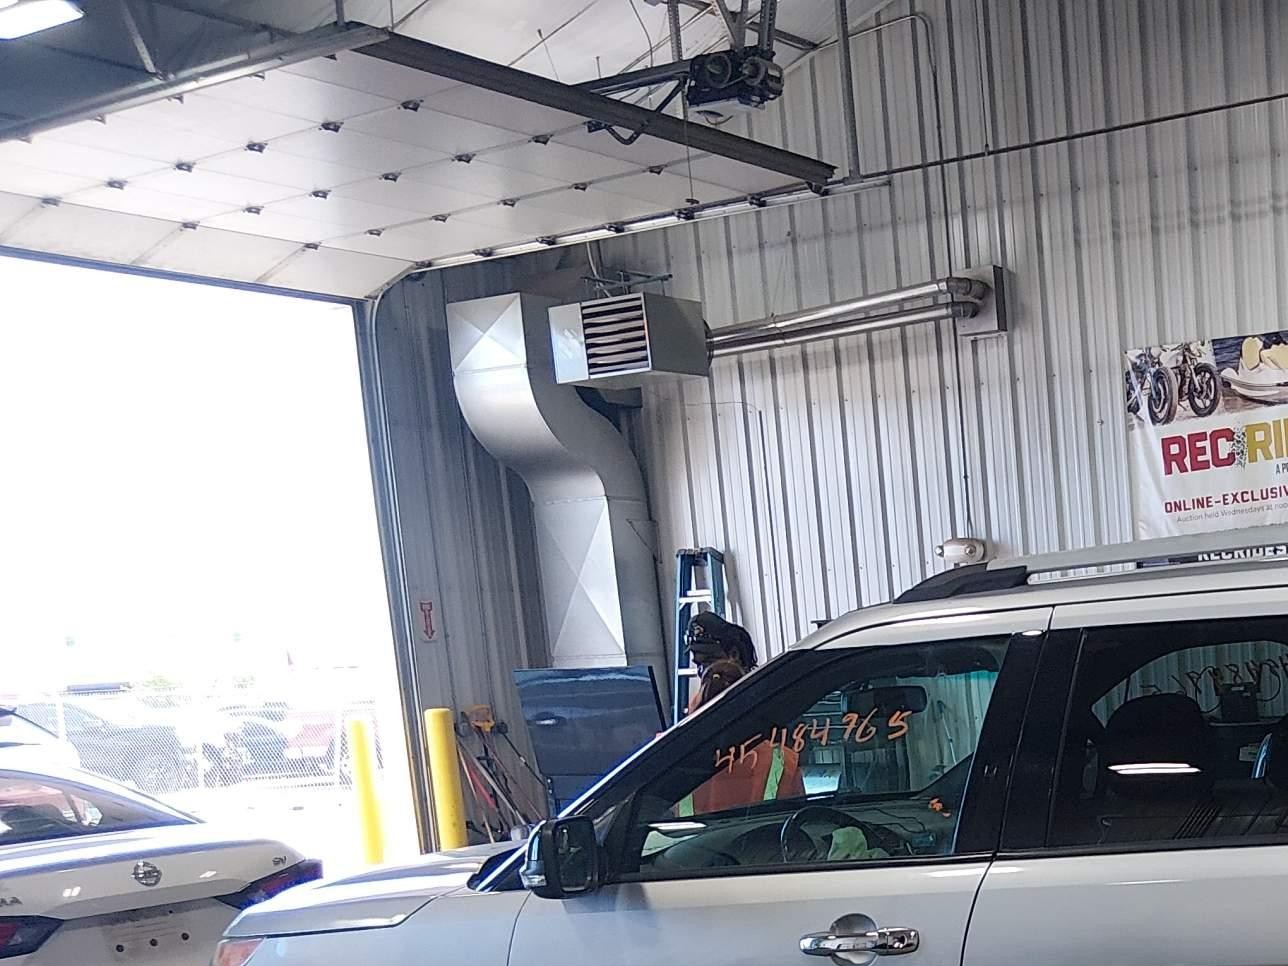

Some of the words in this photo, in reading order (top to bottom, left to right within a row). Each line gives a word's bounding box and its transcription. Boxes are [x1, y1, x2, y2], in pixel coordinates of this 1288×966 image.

[1161, 427, 1236, 476] REC
[1275, 465, 1281, 475] A
[1176, 511, 1204, 523] Auction
